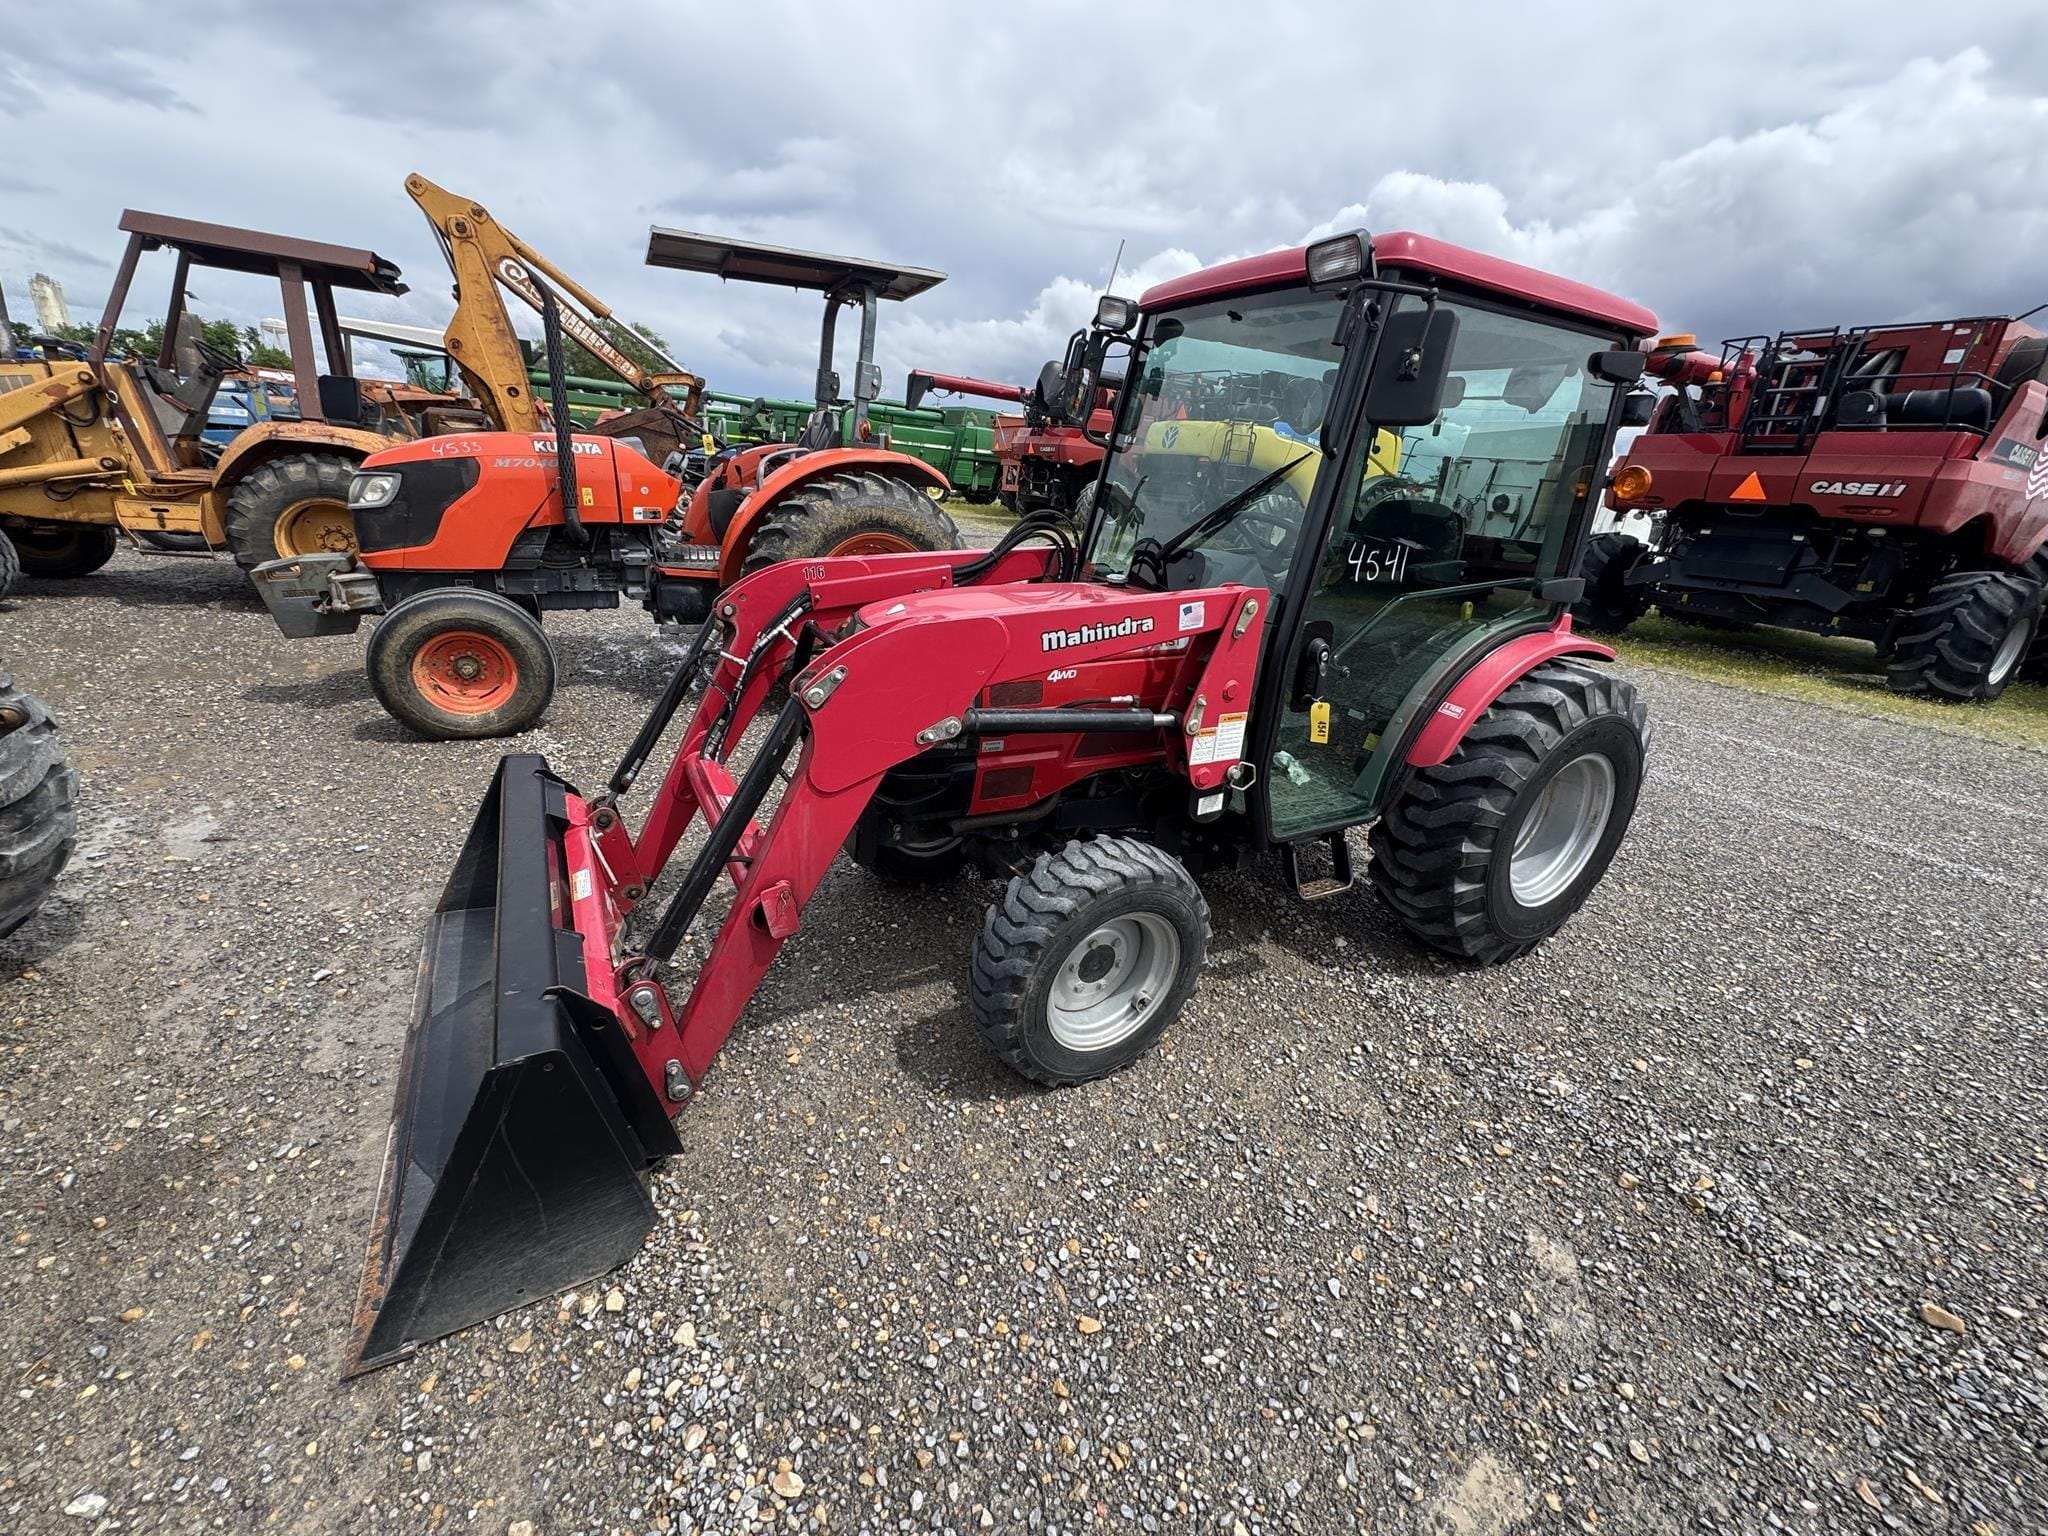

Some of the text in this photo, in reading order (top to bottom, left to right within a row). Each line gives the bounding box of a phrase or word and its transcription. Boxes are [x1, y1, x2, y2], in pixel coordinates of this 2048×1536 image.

[533, 440, 602, 455] KUOTA
[1348, 542, 1409, 582] 4541
[802, 565, 825, 580] 116
[1041, 617, 1154, 651] Mahindra
[1047, 670, 1077, 682] 4WD
[1317, 720, 1327, 737] 4541
